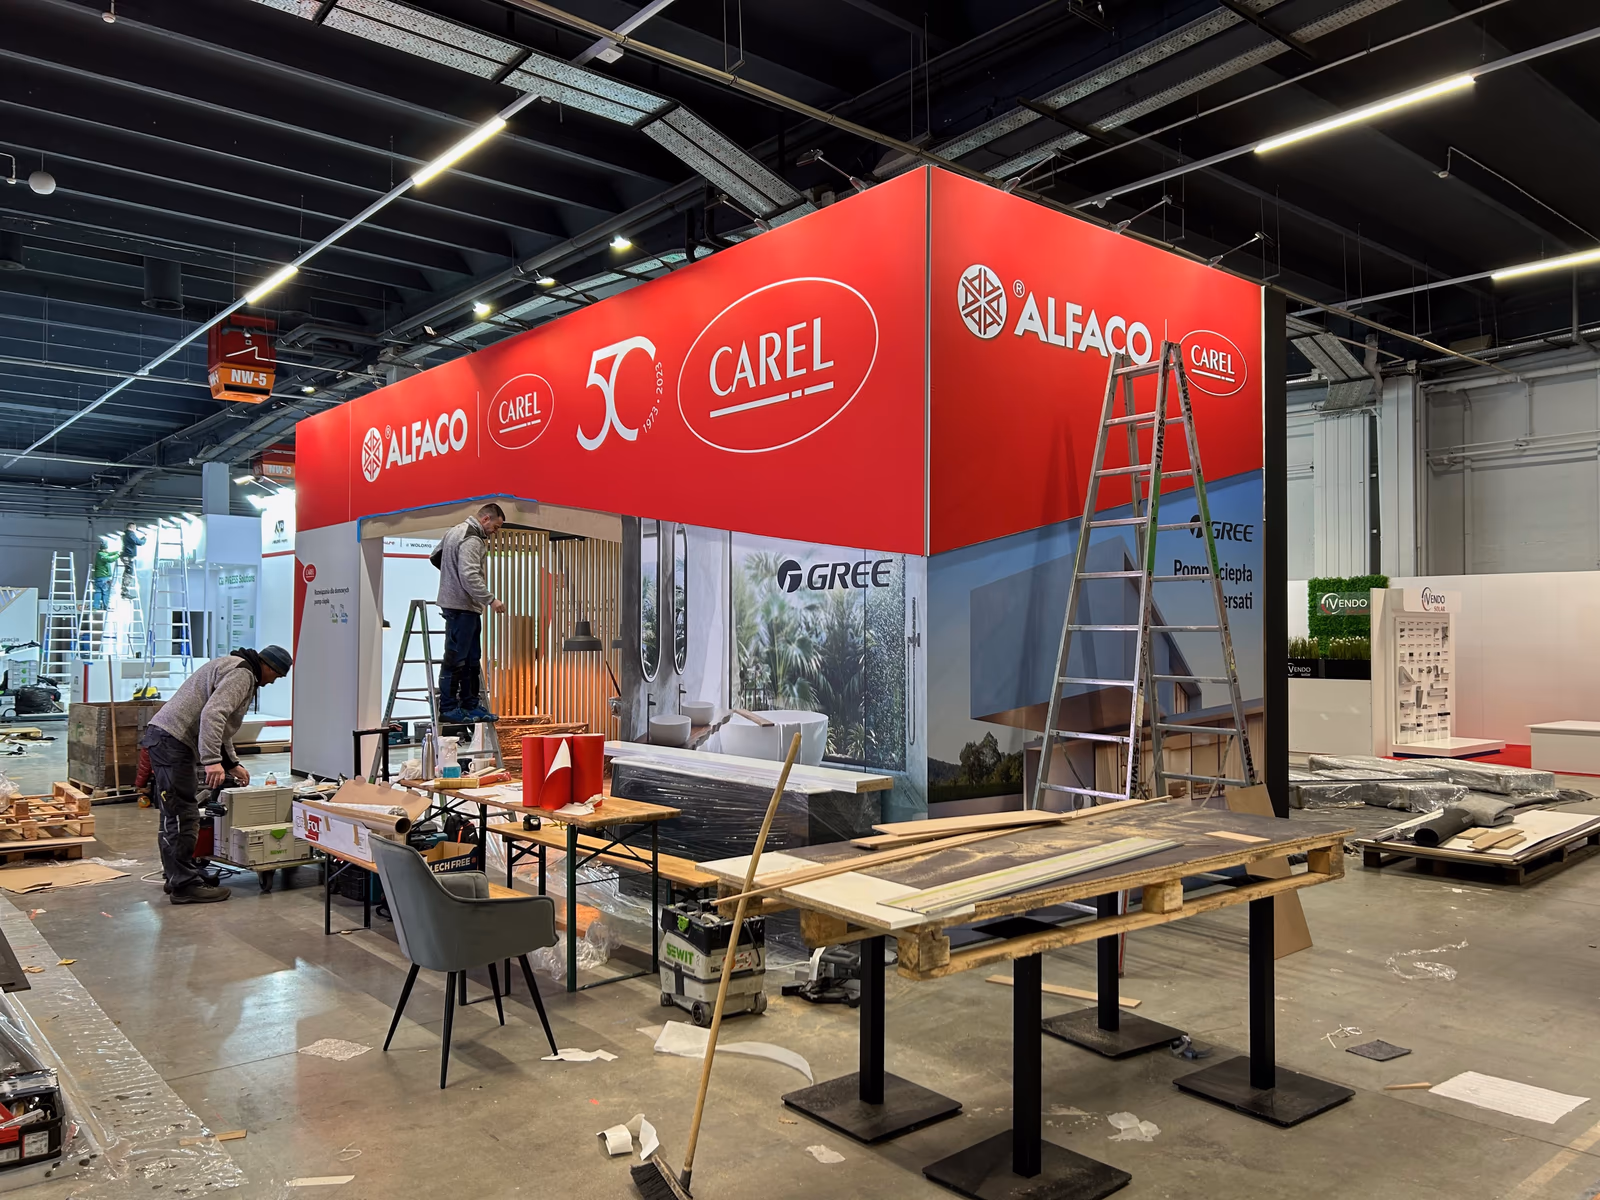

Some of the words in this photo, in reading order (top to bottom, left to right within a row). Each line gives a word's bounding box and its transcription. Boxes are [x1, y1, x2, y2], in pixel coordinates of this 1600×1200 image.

[1013, 290, 1153, 365] ALFACO
[709, 317, 834, 397] CAREL
[1191, 344, 1235, 375] CAREL
[231, 369, 267, 386] NW-5
[499, 391, 541, 424] CAREL
[642, 406, 659, 433] 1973
[655, 361, 664, 395] 2023
[385, 408, 468, 469] ALFACO
[1156, 418, 1166, 462] SEWIT
[268, 465, 292, 475] NW-3
[1211, 521, 1254, 542] GREE
[807, 559, 893, 590] GREE
[1174, 559, 1211, 583] Pomp
[1224, 592, 1252, 609] ersati
[430, 862, 450, 873] LECH
[451, 857, 471, 869] FREE
[666, 942, 695, 965] SEWIT
